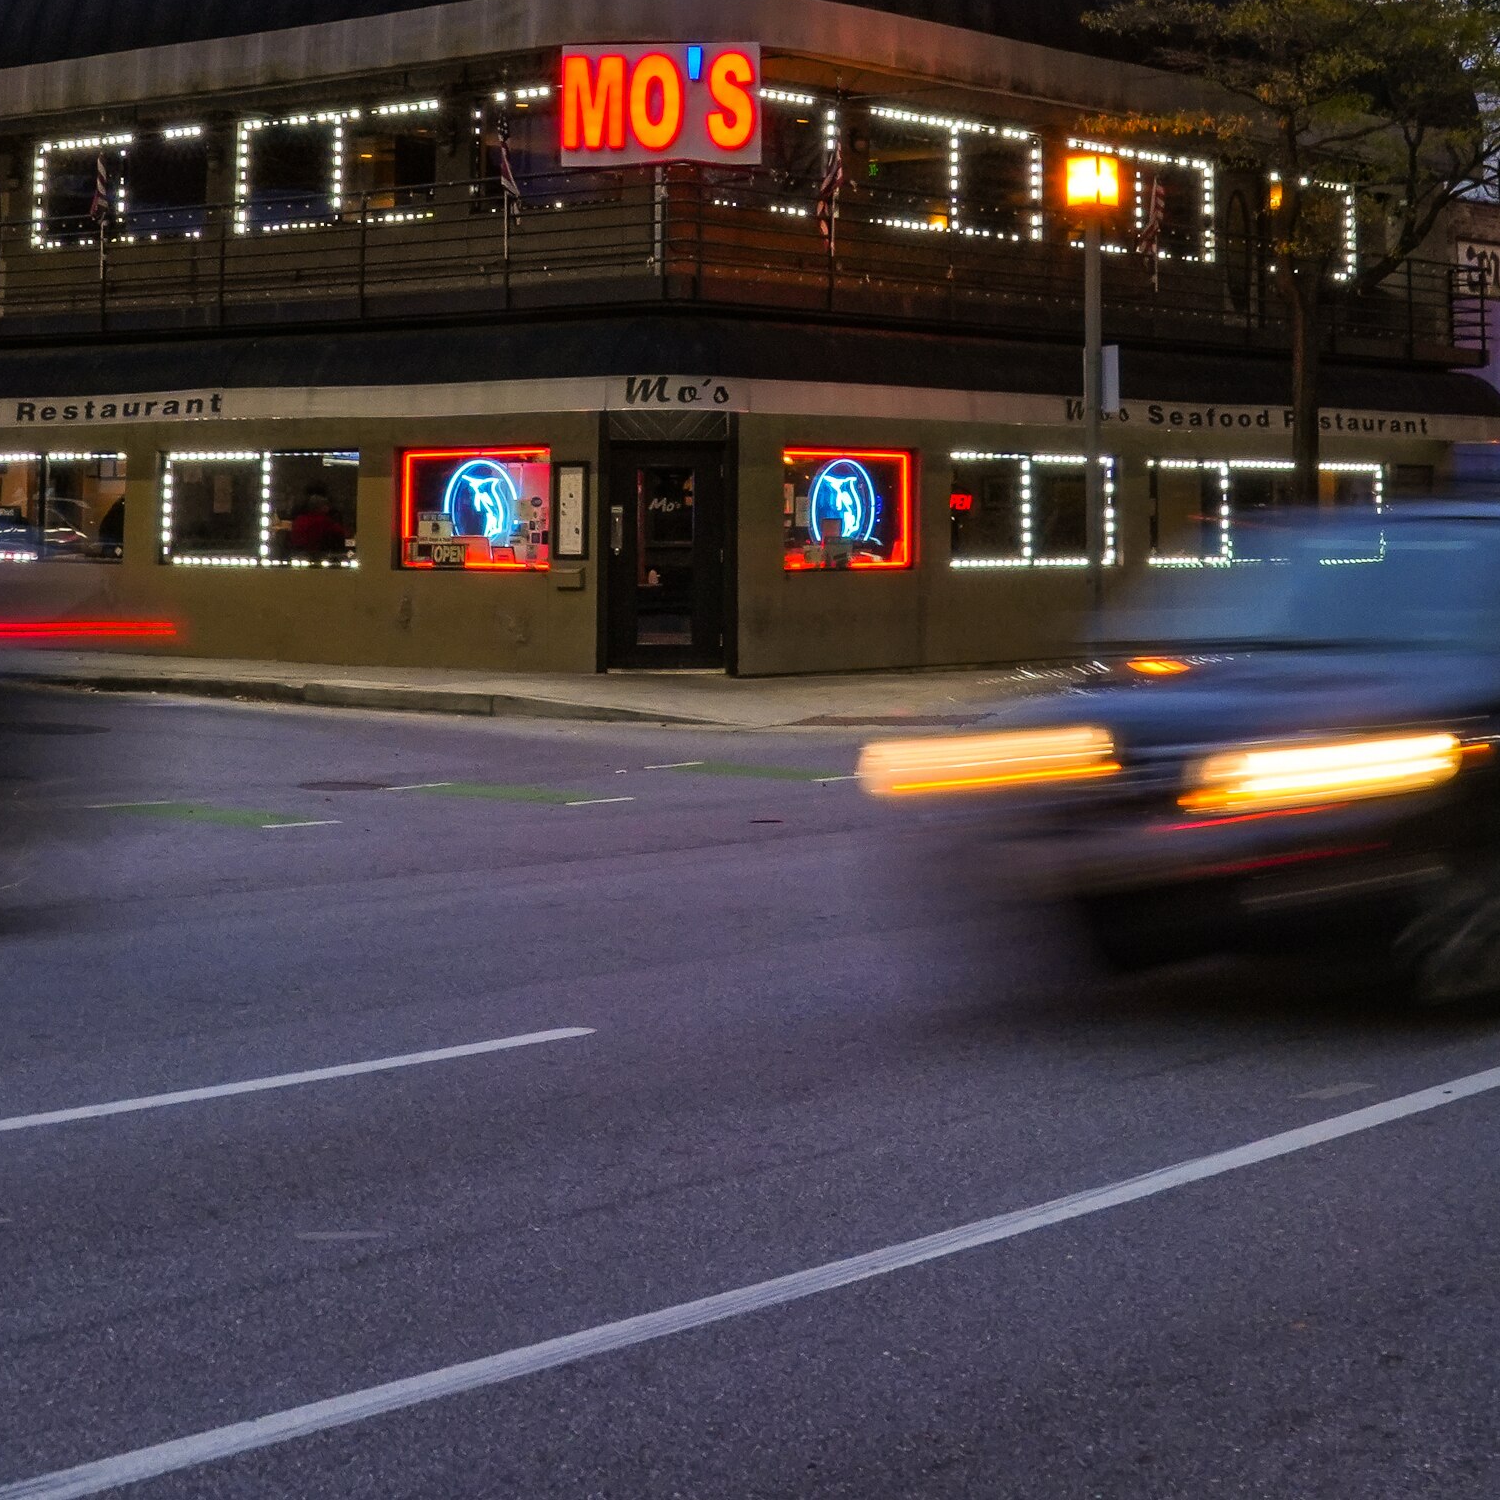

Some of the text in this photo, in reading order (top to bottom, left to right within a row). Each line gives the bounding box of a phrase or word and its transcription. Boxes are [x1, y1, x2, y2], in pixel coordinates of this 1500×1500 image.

[562, 45, 757, 152] MO'S
[626, 376, 730, 405] Mo's
[15, 392, 223, 424] Restaurant
[1148, 404, 1270, 428] Seafood
[1284, 409, 1429, 435] Rstaurant
[949, 493, 973, 510] PEN
[433, 545, 465, 563] OPEN
